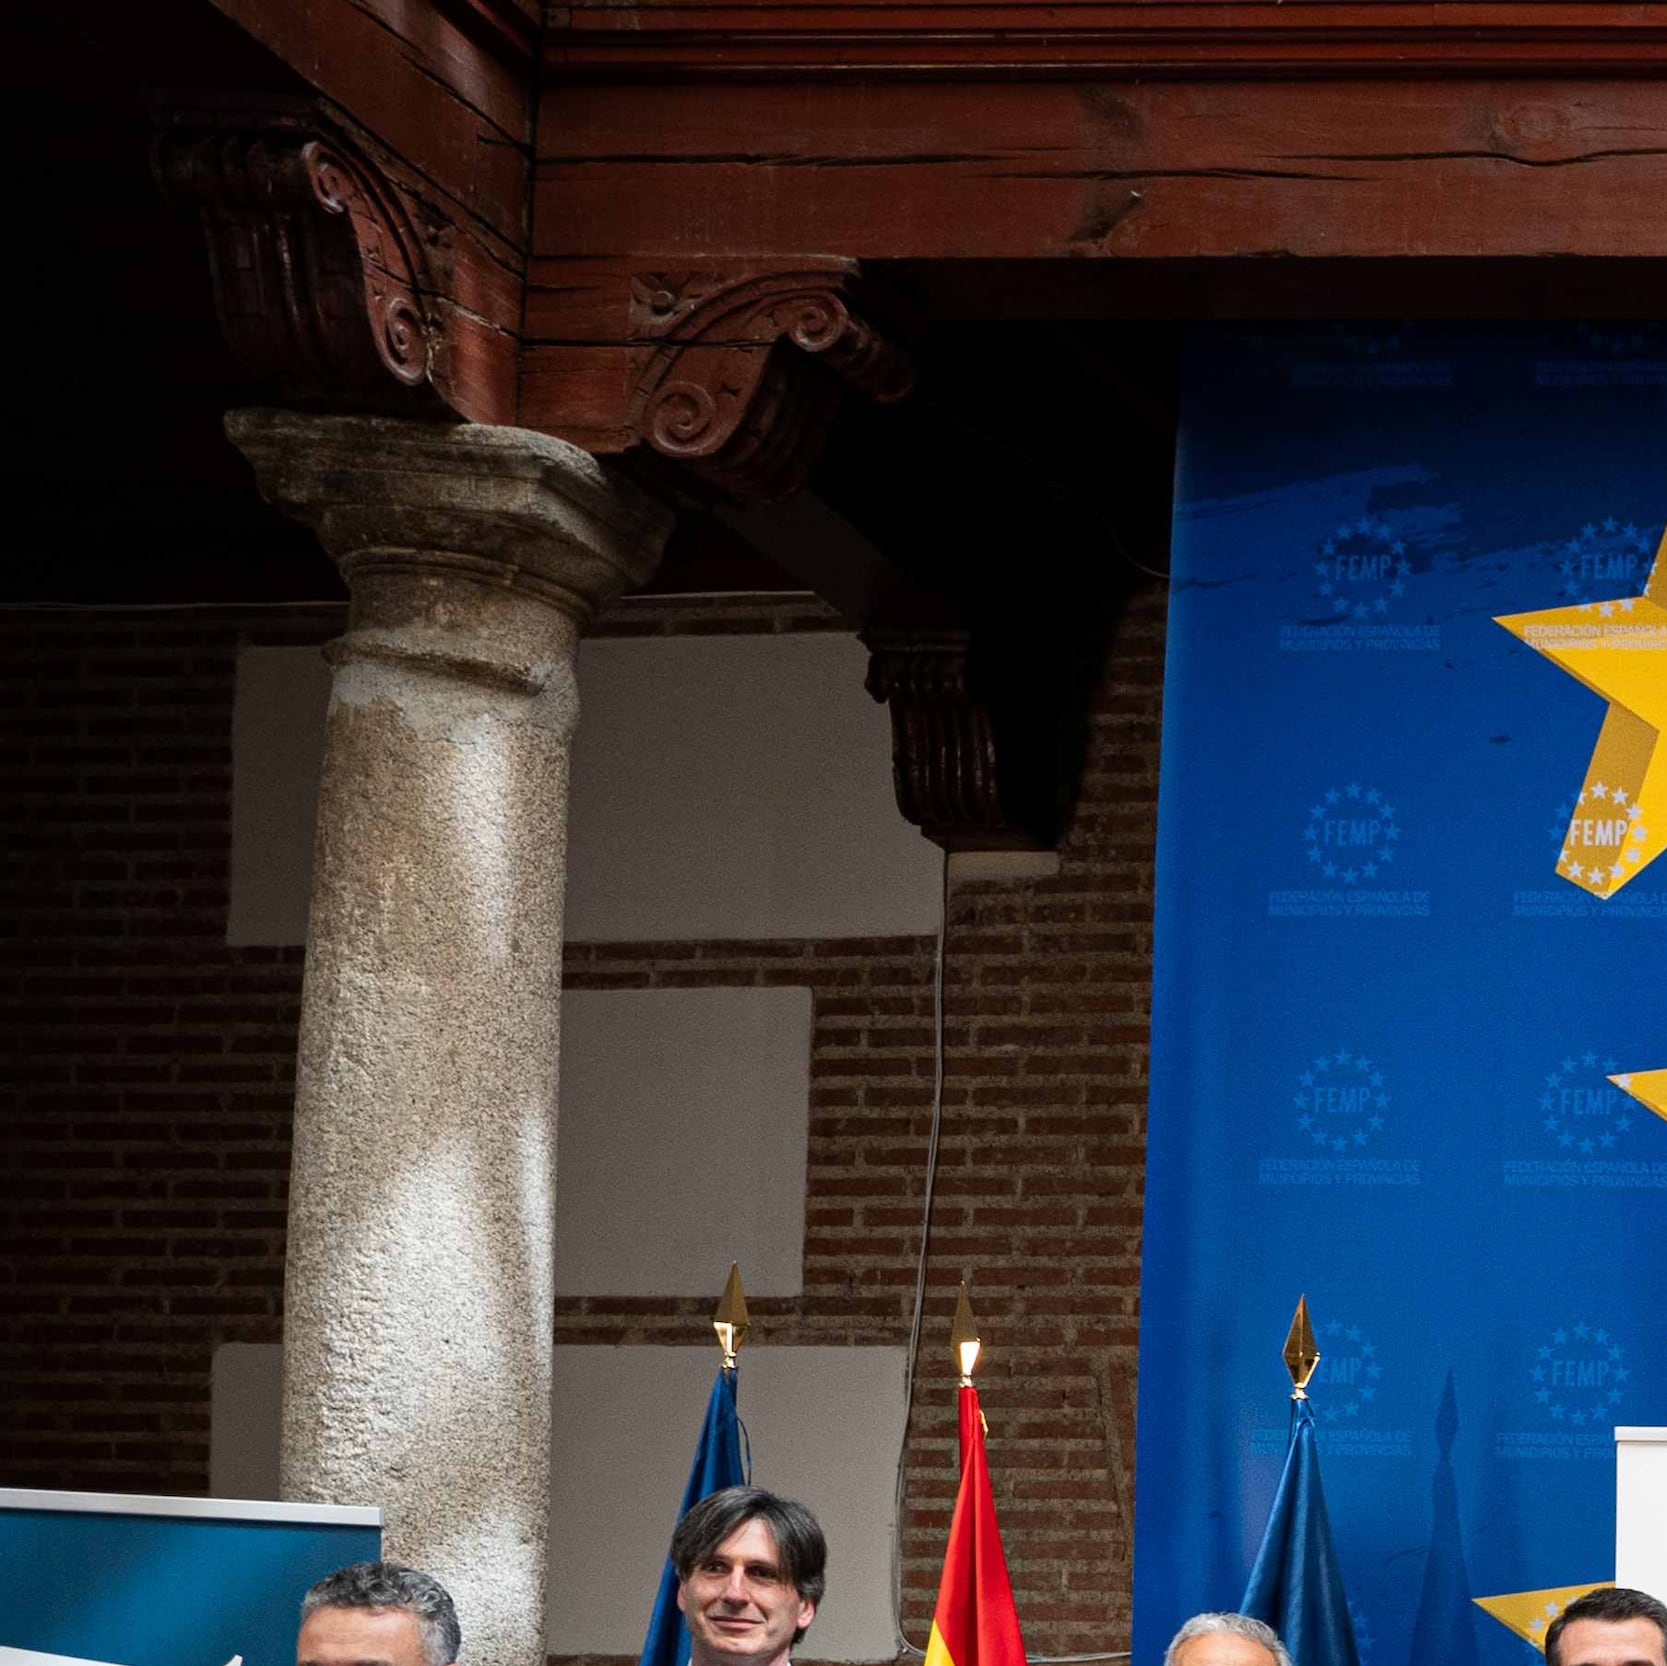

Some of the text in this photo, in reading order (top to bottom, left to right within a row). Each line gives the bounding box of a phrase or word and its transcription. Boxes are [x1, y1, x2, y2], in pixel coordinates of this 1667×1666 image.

[1323, 821, 1379, 844] FEMP
[1570, 821, 1628, 846] FEMP
[1314, 1089, 1371, 1113] FEMP
[1560, 1090, 1616, 1115] FEMP
[1551, 1361, 1609, 1386] FEMP
